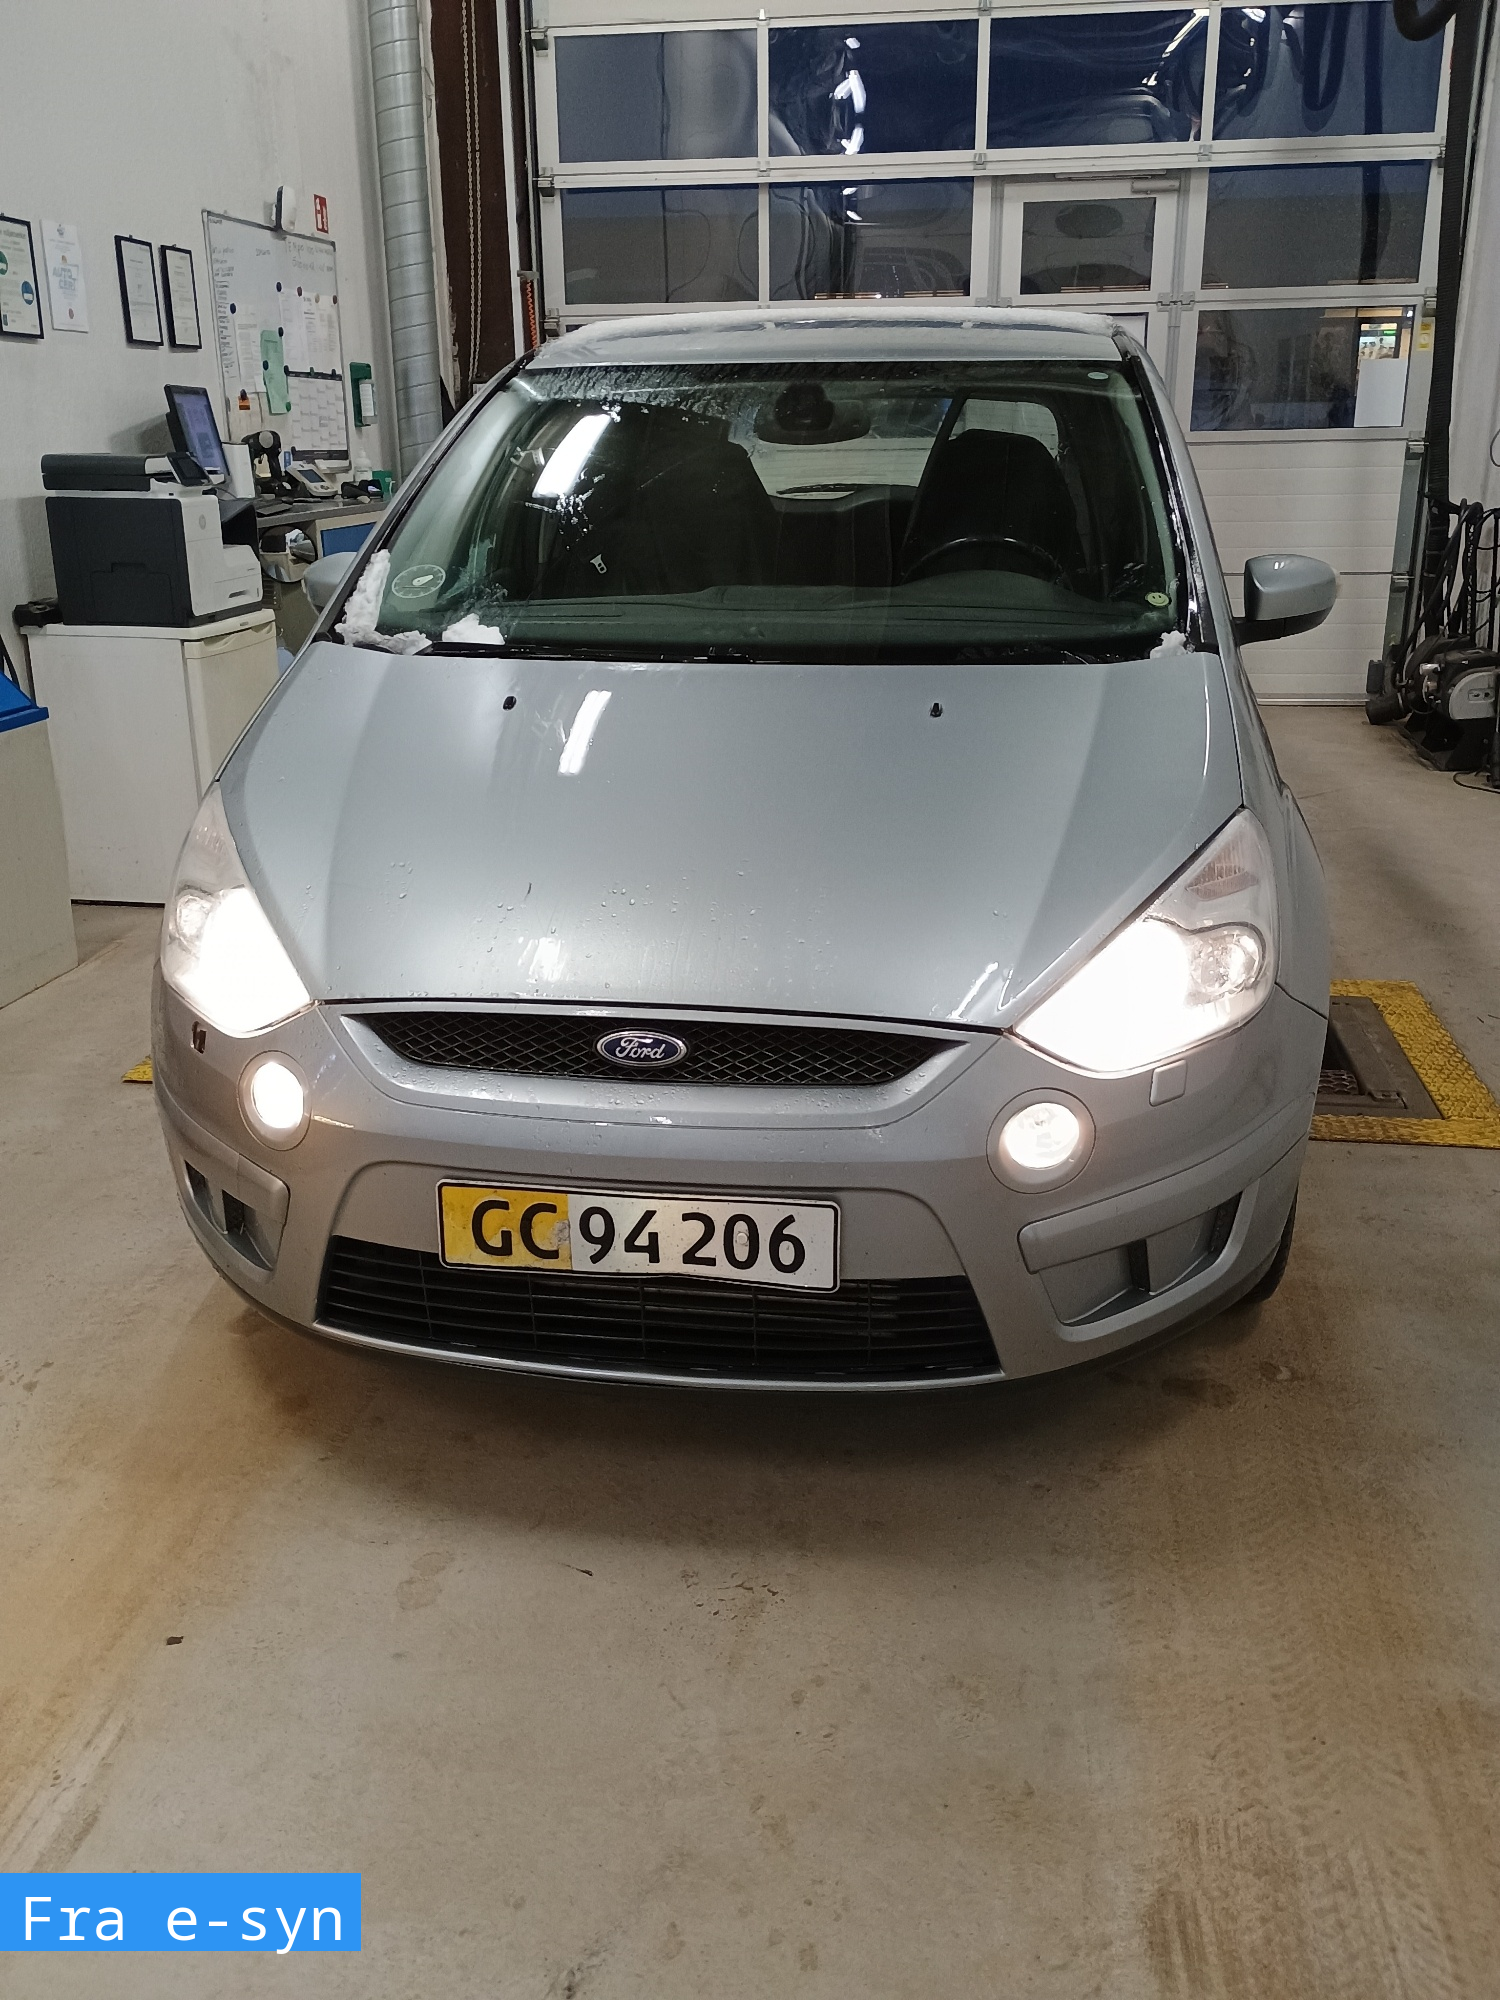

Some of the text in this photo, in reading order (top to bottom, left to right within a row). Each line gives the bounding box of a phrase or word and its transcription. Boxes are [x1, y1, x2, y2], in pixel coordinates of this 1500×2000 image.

[615, 1037, 666, 1059] Ford
[471, 1199, 806, 1274] GC 94 206
